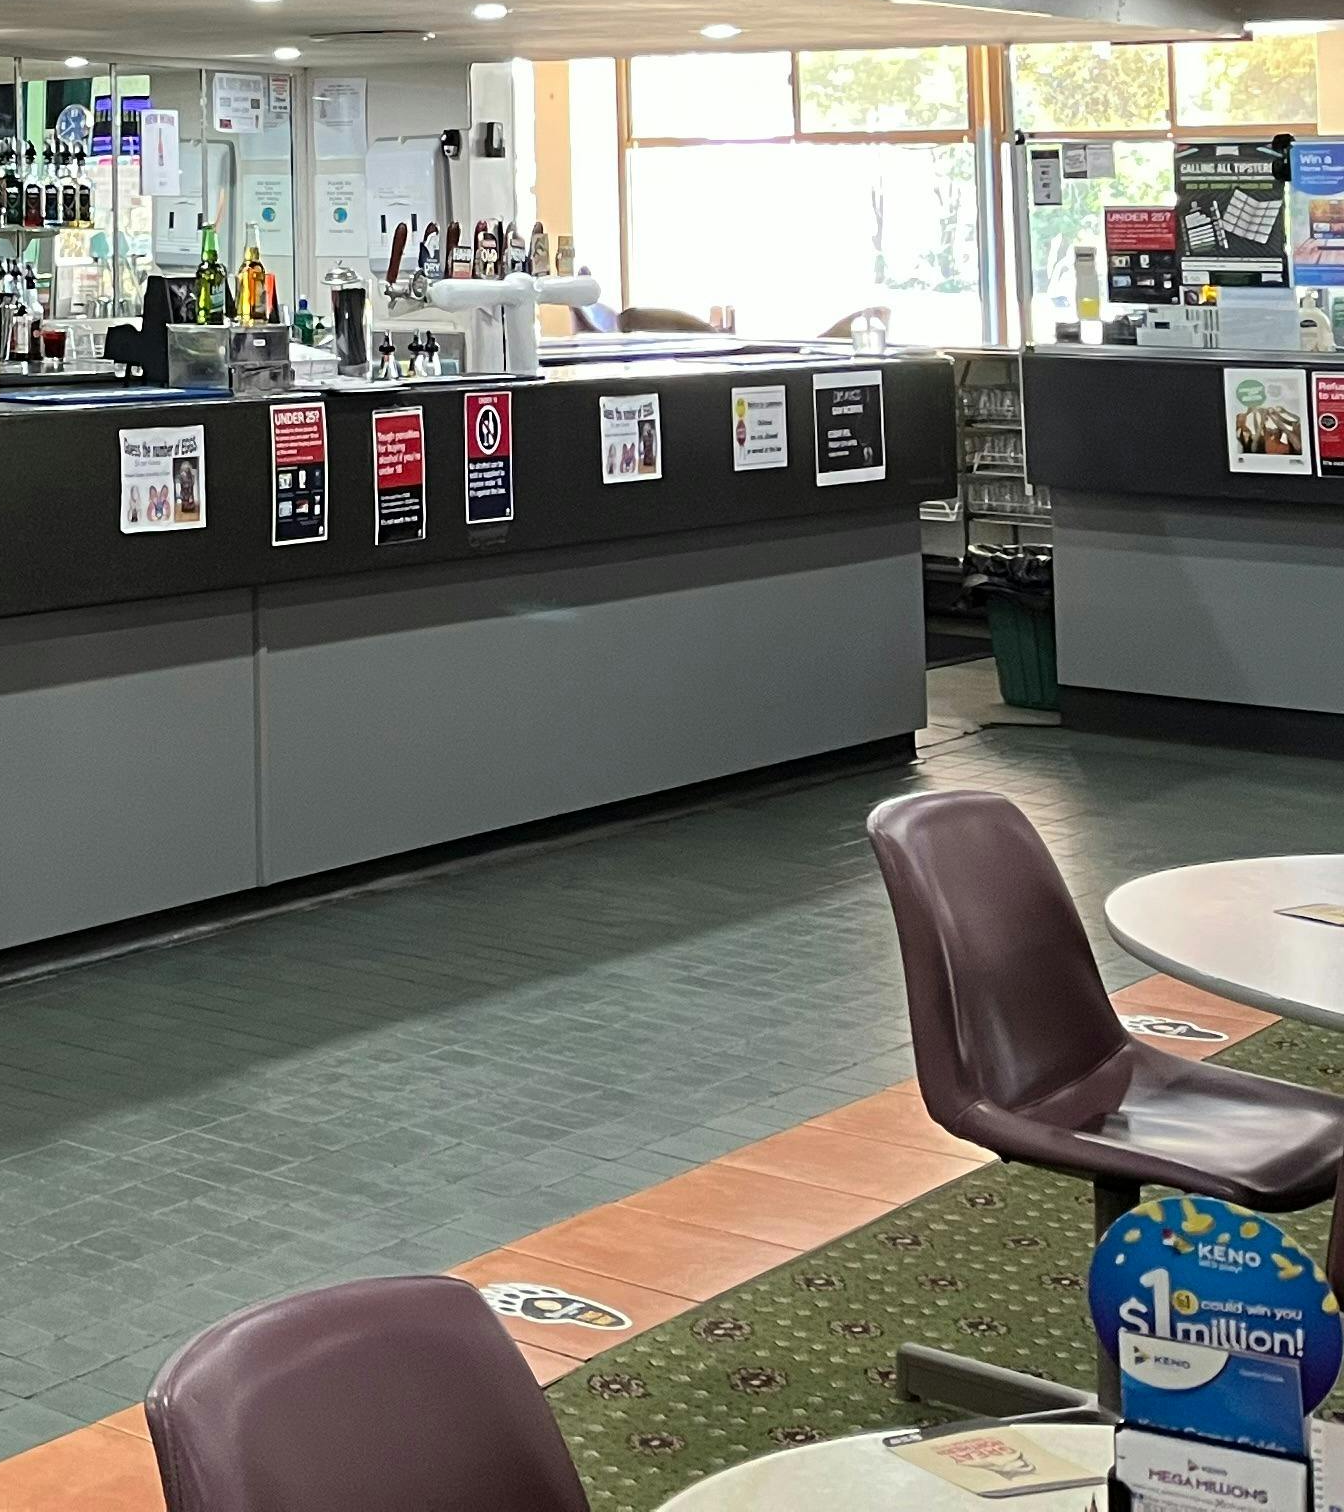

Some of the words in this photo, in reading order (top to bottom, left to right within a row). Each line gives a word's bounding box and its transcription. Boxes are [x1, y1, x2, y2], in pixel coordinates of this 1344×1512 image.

[1300, 154, 1322, 164] Win
[1323, 155, 1332, 164] a
[1180, 163, 1214, 174] CALLING
[1216, 162, 1231, 173] ALL
[1106, 211, 1150, 222] UNDER
[1151, 213, 1172, 222] 25?
[1319, 392, 1330, 400] to
[274, 411, 305, 425] UNDER
[305, 410, 320, 424] 25?
[152, 441, 173, 457] number
[1198, 1242, 1262, 1268] KENO
[1200, 1299, 1243, 1314] could
[1245, 1304, 1271, 1316] win
[1273, 1308, 1303, 1322] you
[1176, 1317, 1305, 1358] million!
[1153, 1355, 1191, 1370] KENO
[1148, 1467, 1196, 1490] MEGA
[1195, 1480, 1269, 1506] MILLIONS
